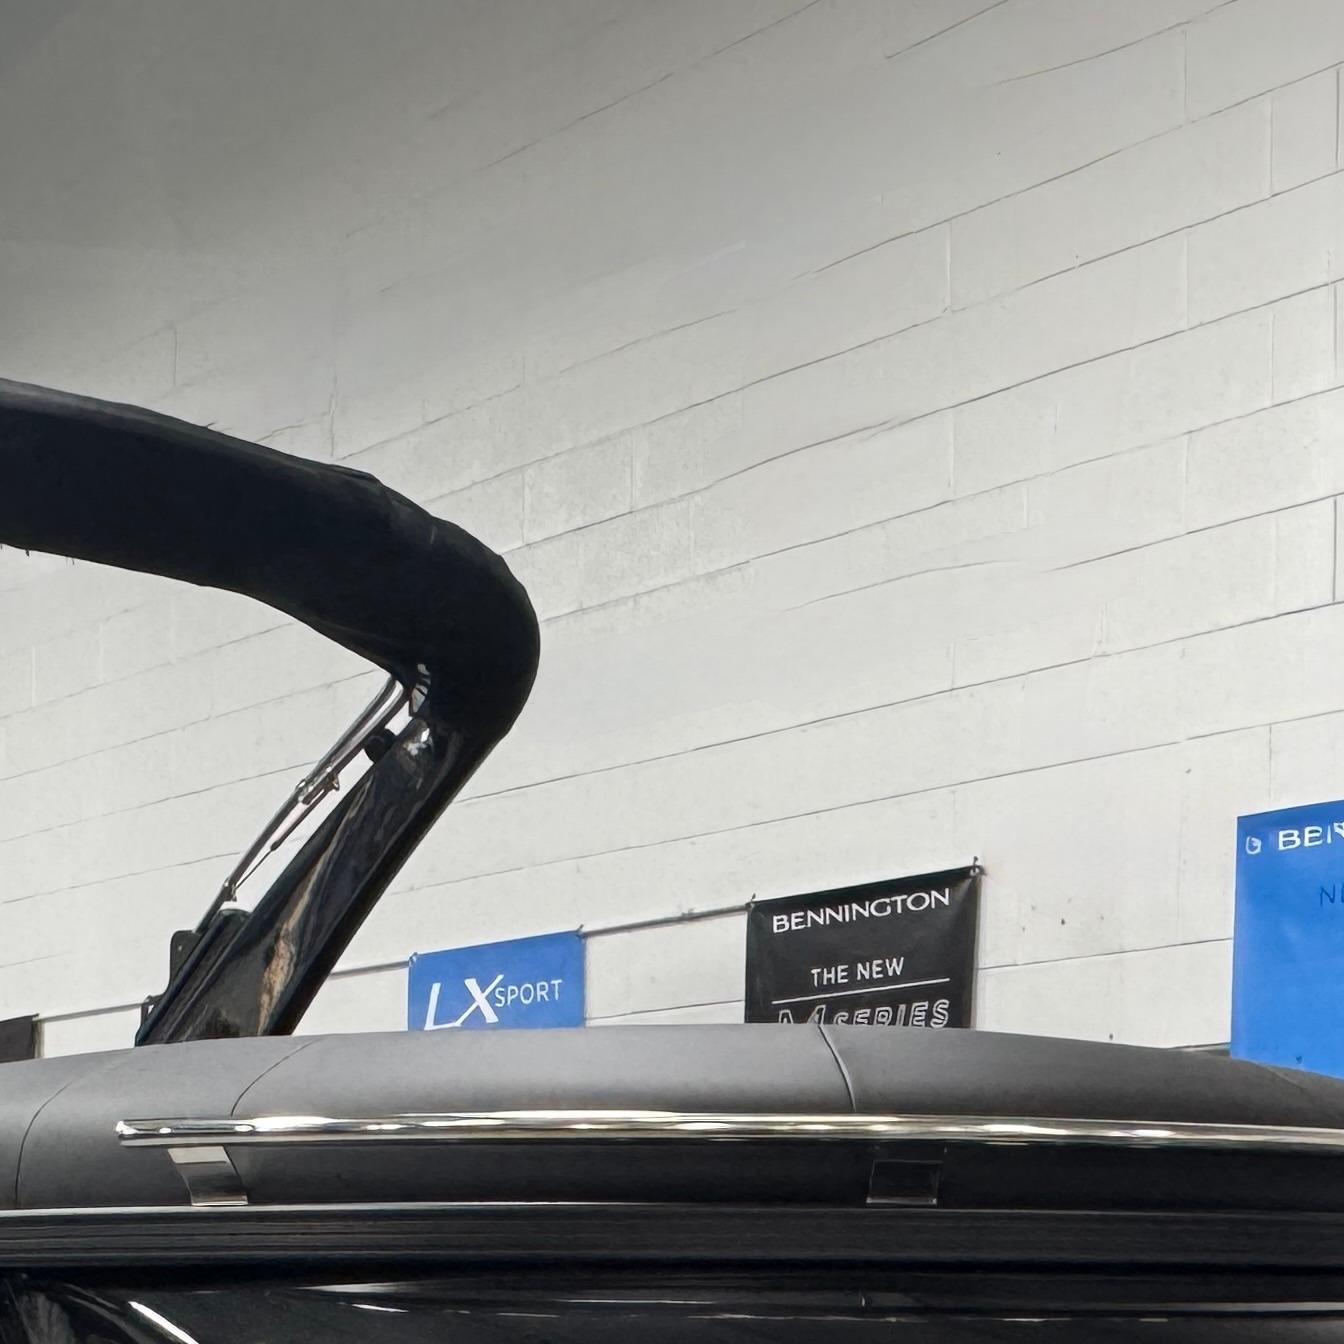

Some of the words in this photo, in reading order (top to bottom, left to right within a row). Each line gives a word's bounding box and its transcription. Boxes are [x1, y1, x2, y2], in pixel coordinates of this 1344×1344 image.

[772, 887, 950, 934] BENNINGTON
[811, 963, 849, 988] THE
[856, 957, 905, 981] NEW
[494, 979, 563, 1008] SPORT
